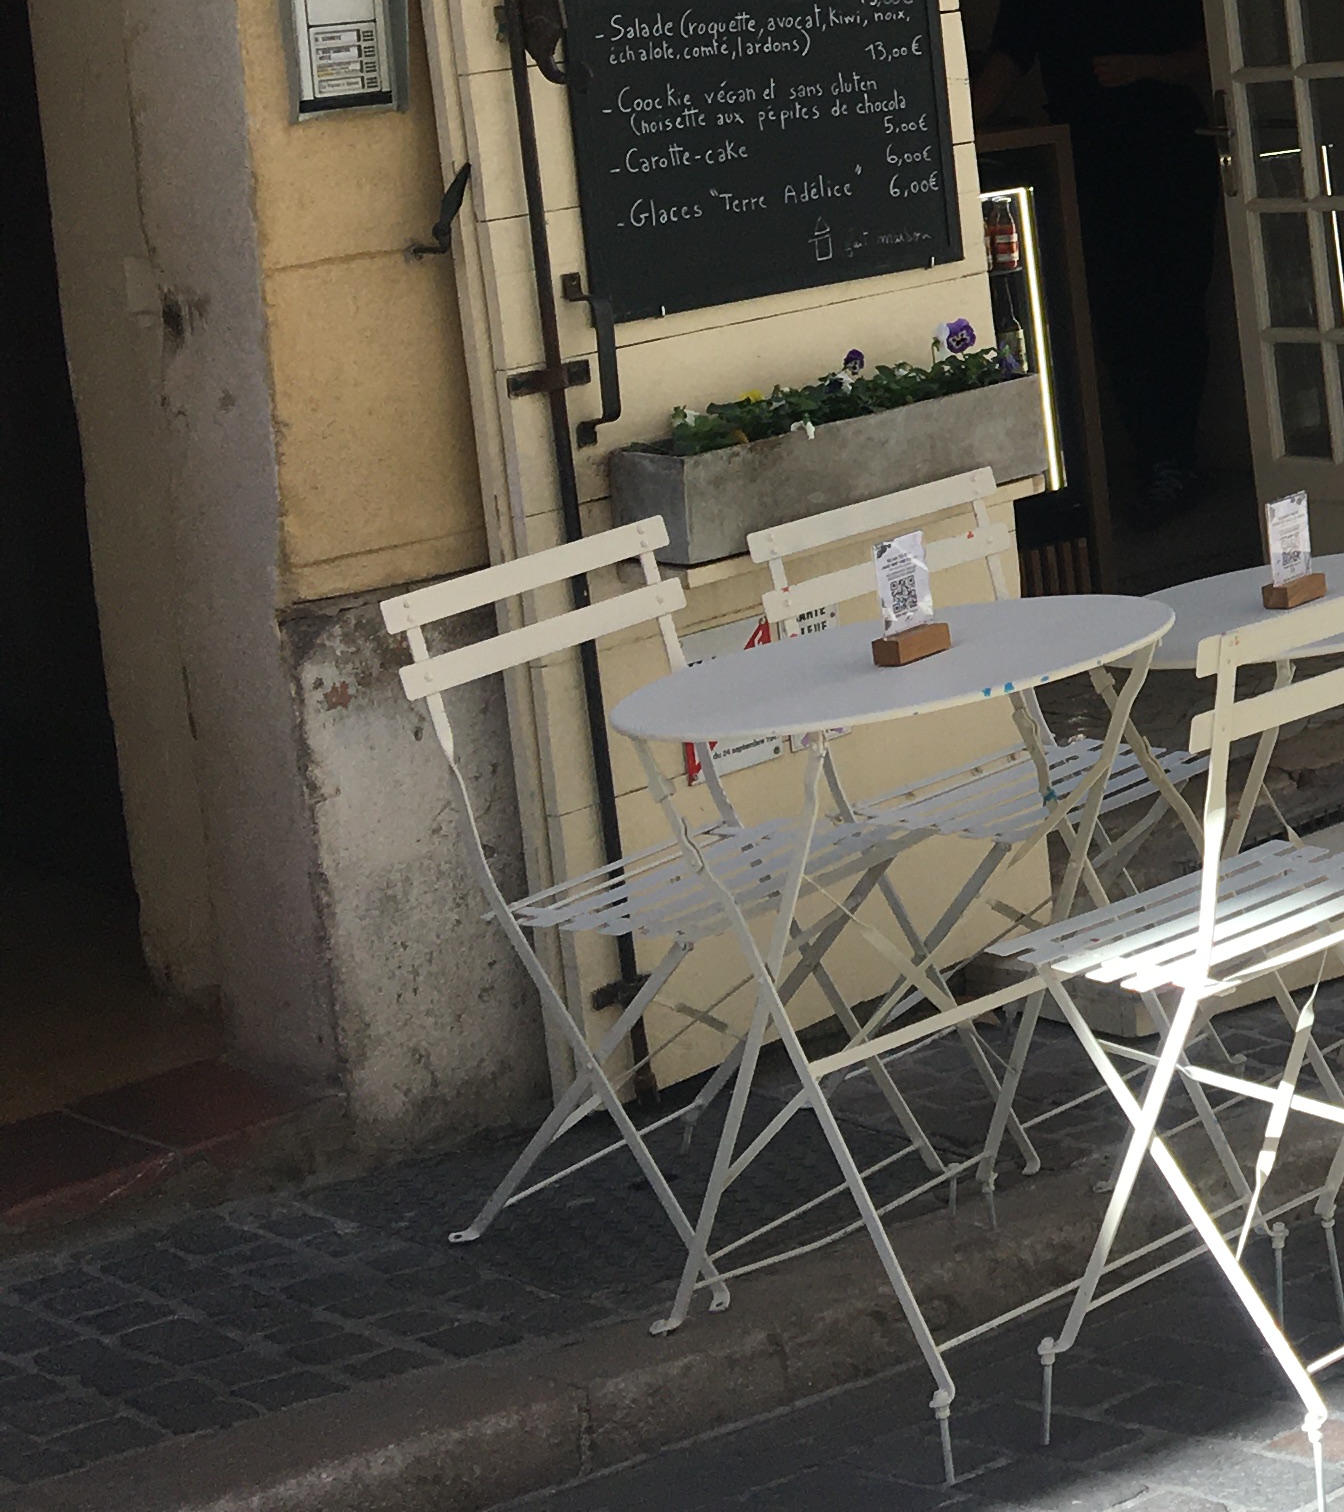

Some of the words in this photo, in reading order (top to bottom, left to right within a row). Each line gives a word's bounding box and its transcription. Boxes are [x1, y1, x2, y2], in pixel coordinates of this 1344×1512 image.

[865, 35, 923, 63] 13,00€
[705, 80, 756, 106] végan
[762, 78, 776, 100] et
[790, 84, 823, 100] sans
[831, 72, 877, 93] gluten
[630, 108, 706, 136] (noisette
[717, 109, 745, 125] aux
[758, 100, 820, 133] pépites
[831, 99, 849, 116] de
[884, 115, 928, 134] 5,00€
[886, 143, 932, 166] 6,00€
[888, 171, 939, 198] 6,00€
[732, 739, 764, 753] septembre
